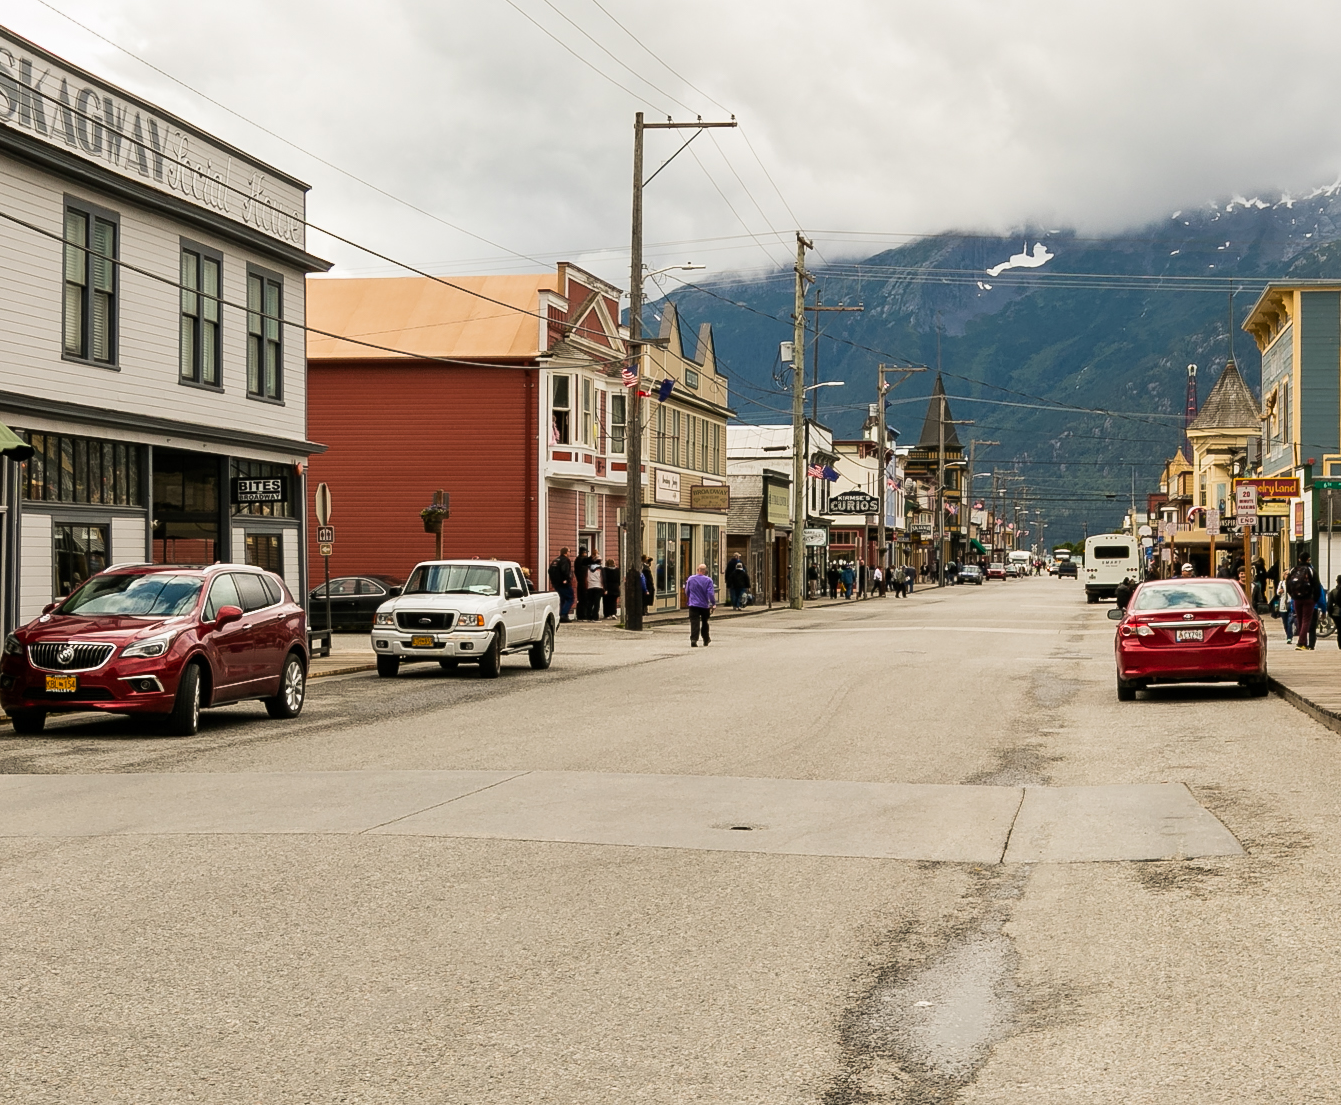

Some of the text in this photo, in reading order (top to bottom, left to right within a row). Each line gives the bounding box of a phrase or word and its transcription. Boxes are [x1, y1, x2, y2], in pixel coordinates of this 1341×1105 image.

[167, 130, 232, 213] Social
[242, 169, 303, 243] House
[239, 480, 281, 491] BITES
[830, 500, 878, 511] CURIOS
